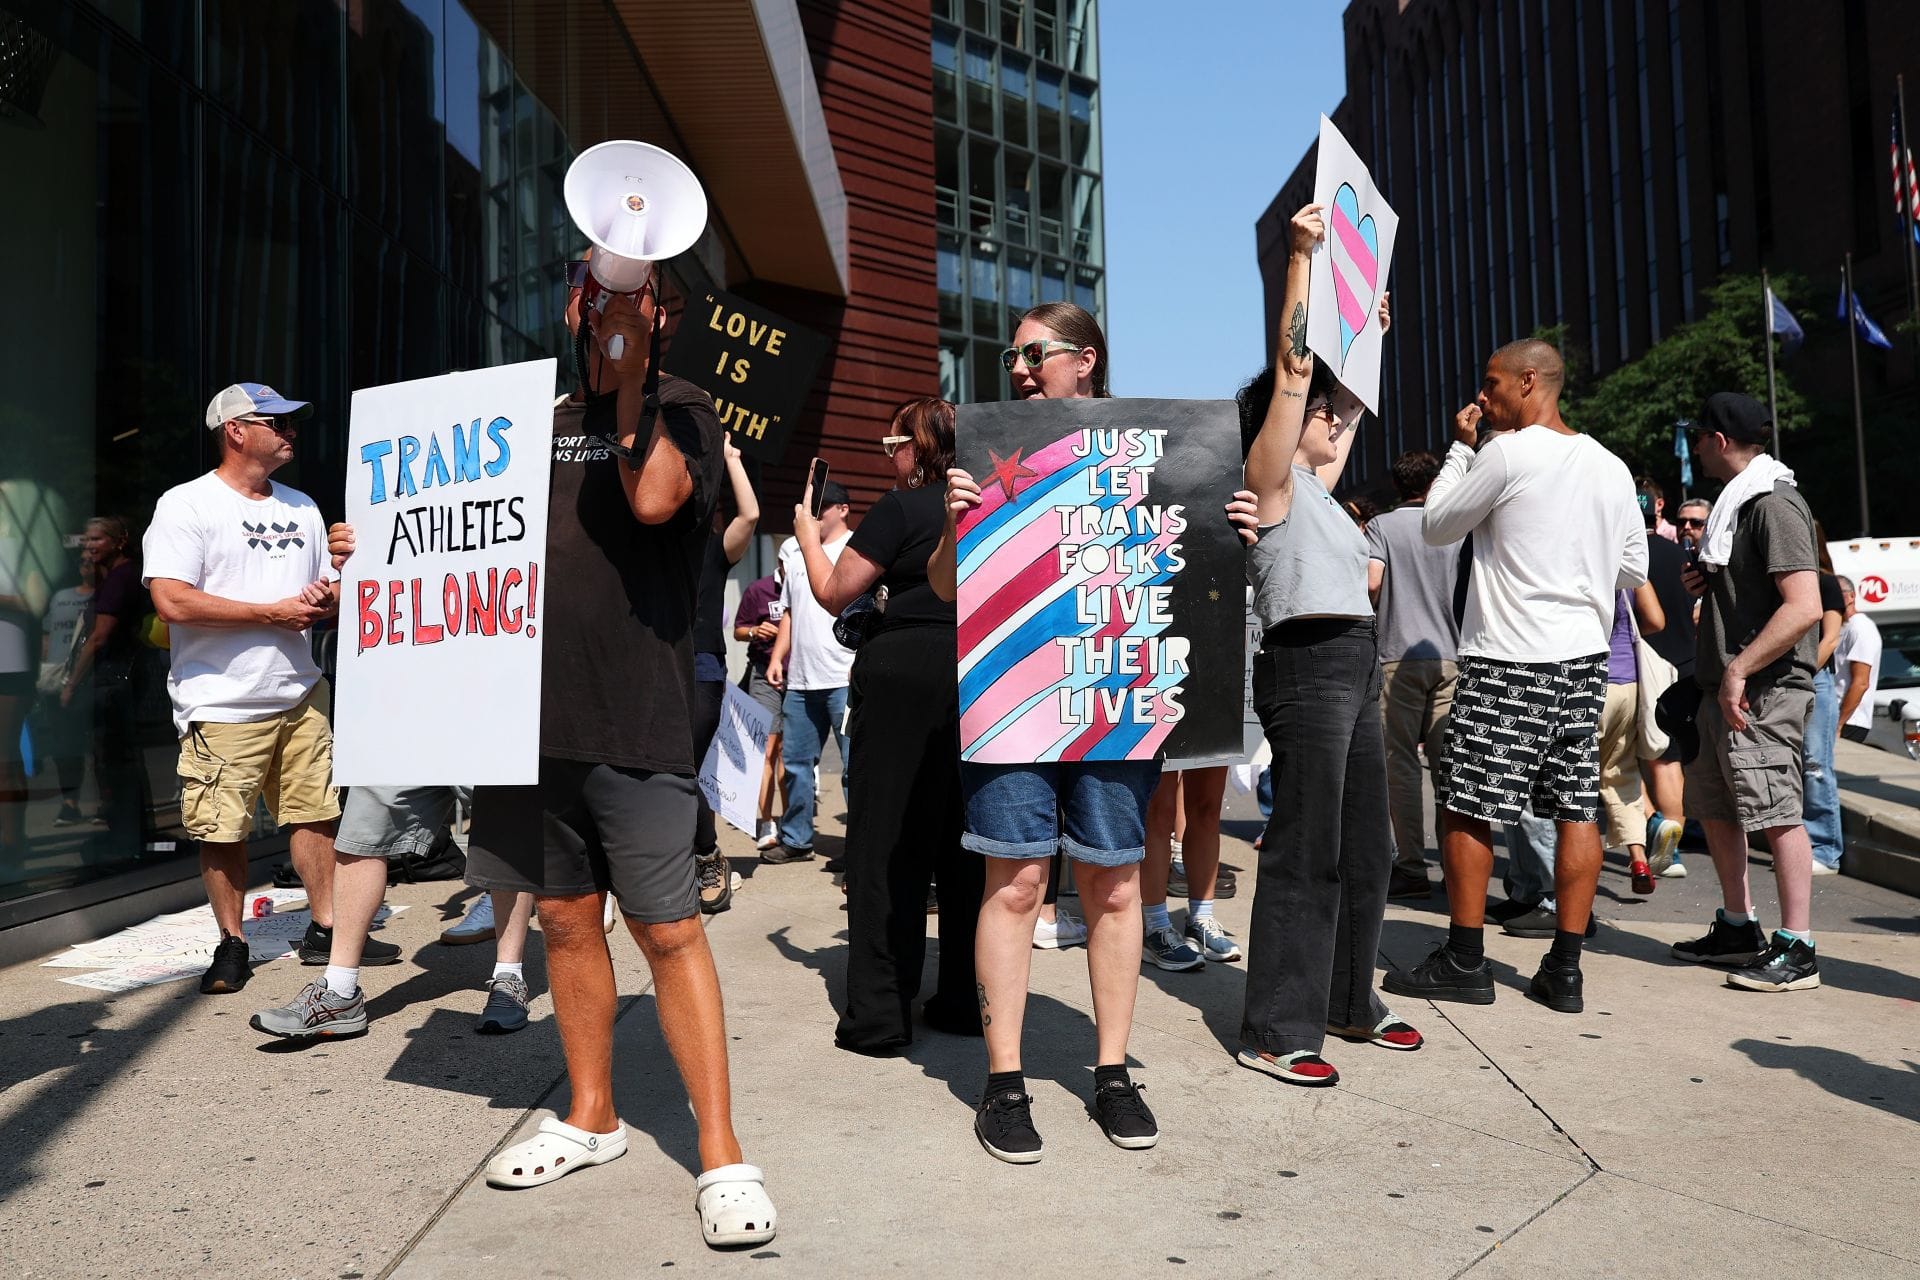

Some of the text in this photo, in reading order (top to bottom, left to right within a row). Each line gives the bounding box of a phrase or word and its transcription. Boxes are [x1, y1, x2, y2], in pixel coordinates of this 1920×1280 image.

[715, 351, 750, 383] IS
[714, 398, 780, 440] UTH”
[553, 436, 586, 447] PORT
[574, 449, 609, 462] LIVES
[1071, 428, 1168, 457] JUST
[361, 417, 513, 505] TRANS
[1087, 466, 1155, 496] LET
[387, 497, 525, 565] ATHLETES
[1054, 504, 1188, 535] TRANS
[1058, 543, 1186, 575] FOLKS
[1892, 582, 1920, 594] Metr
[357, 562, 537, 657] BELONG!
[1076, 585, 1174, 624] LIVE
[1055, 636, 1191, 674] THEIR
[1059, 686, 1186, 724] LIVES
[1498, 697, 1528, 707] RAIDERS
[1526, 686, 1556, 695] RAIDERS
[1472, 705, 1500, 716] RAIDERS
[1518, 715, 1548, 726] RAIDERS
[1565, 721, 1595, 729] RAIDERS
[1510, 743, 1538, 754] RAIDERS
[1478, 784, 1505, 795] RAIDERS
